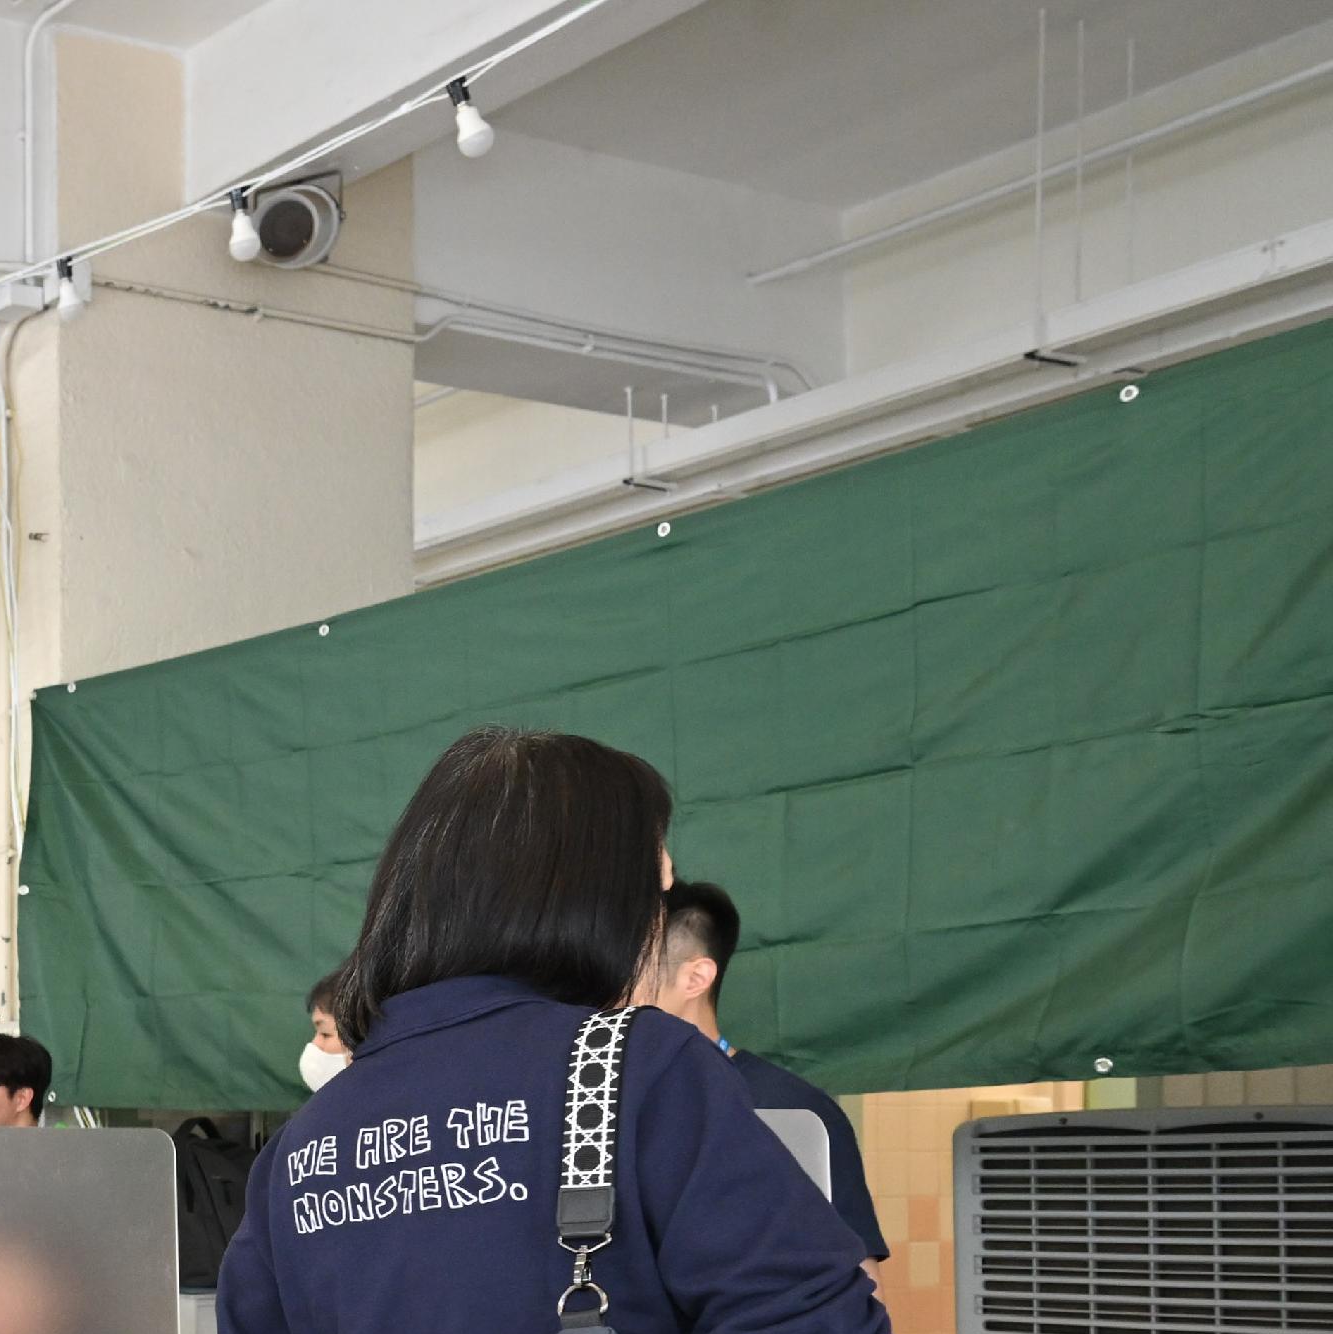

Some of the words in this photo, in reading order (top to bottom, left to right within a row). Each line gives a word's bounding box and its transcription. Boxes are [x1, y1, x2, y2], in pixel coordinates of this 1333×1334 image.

[288, 1136, 337, 1186] WE
[356, 1115, 431, 1169] ARE
[447, 1100, 529, 1149] THE
[293, 1157, 528, 1234] MONSTERS.
